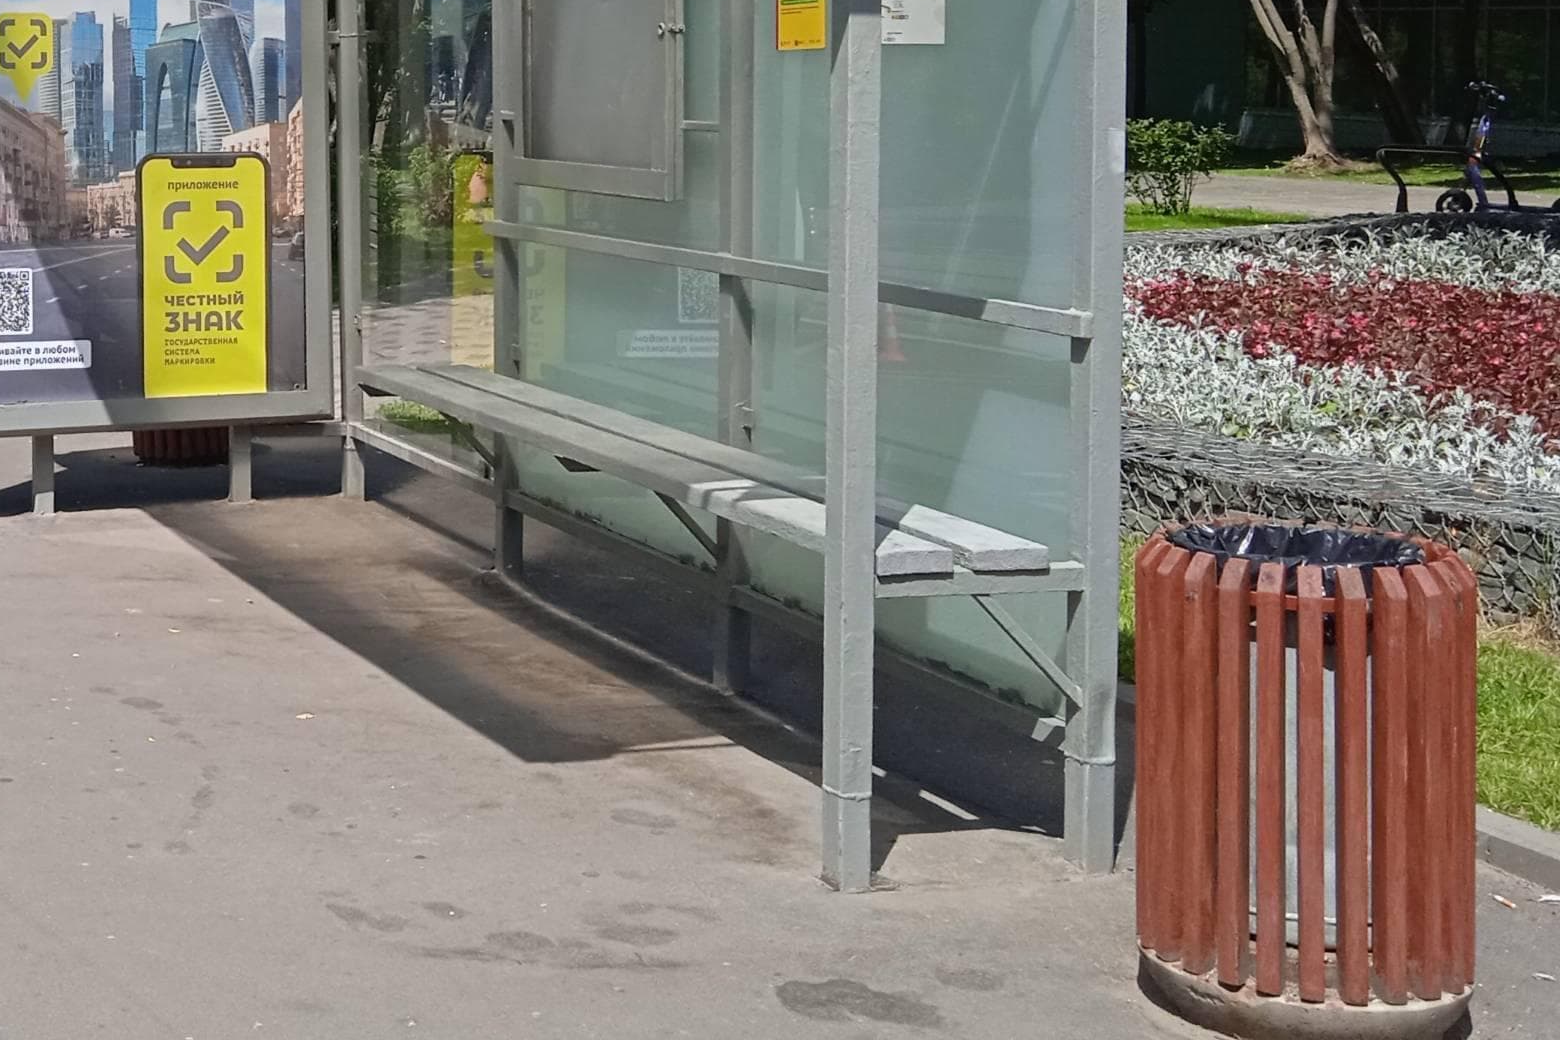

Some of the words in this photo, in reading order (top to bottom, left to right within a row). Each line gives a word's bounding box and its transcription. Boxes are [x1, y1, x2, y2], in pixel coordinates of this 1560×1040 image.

[168, 179, 240, 193] приложение
[164, 291, 244, 307] ЧЕСТНЫЙ
[164, 310, 244, 333] ЗНАК
[164, 337, 238, 346] ГОСУДАРСТВЕННАЯ
[42, 344, 76, 355] любом
[164, 347, 200, 356] СИСТЕМА
[23, 354, 85, 367] приложений
[164, 357, 216, 366] МАРКИРОВКИ
